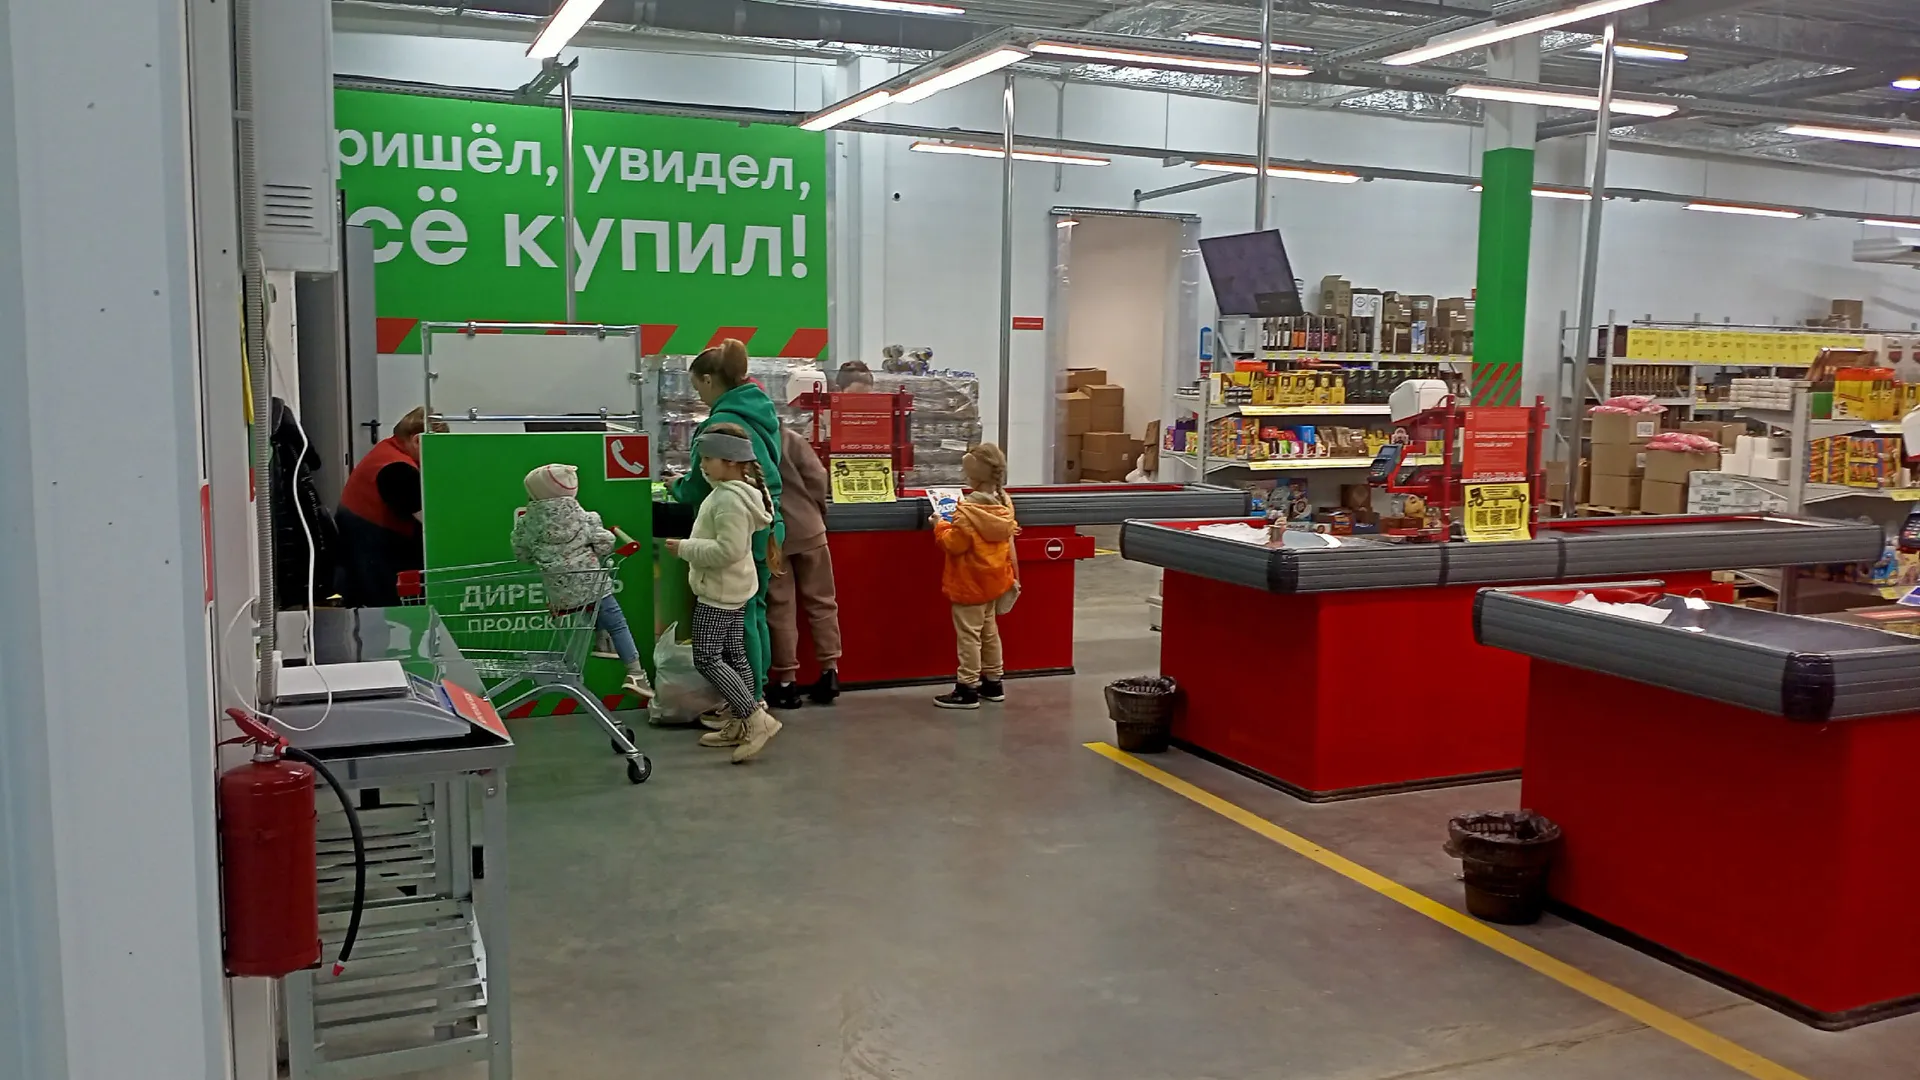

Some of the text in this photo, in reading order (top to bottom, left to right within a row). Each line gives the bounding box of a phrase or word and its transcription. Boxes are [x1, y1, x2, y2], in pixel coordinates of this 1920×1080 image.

[335, 123, 811, 200] ришёл, увидел,
[345, 186, 808, 292] сё купил!
[460, 580, 624, 612] ДИРЕР
[468, 615, 576, 634] ПРОДСКЛ
